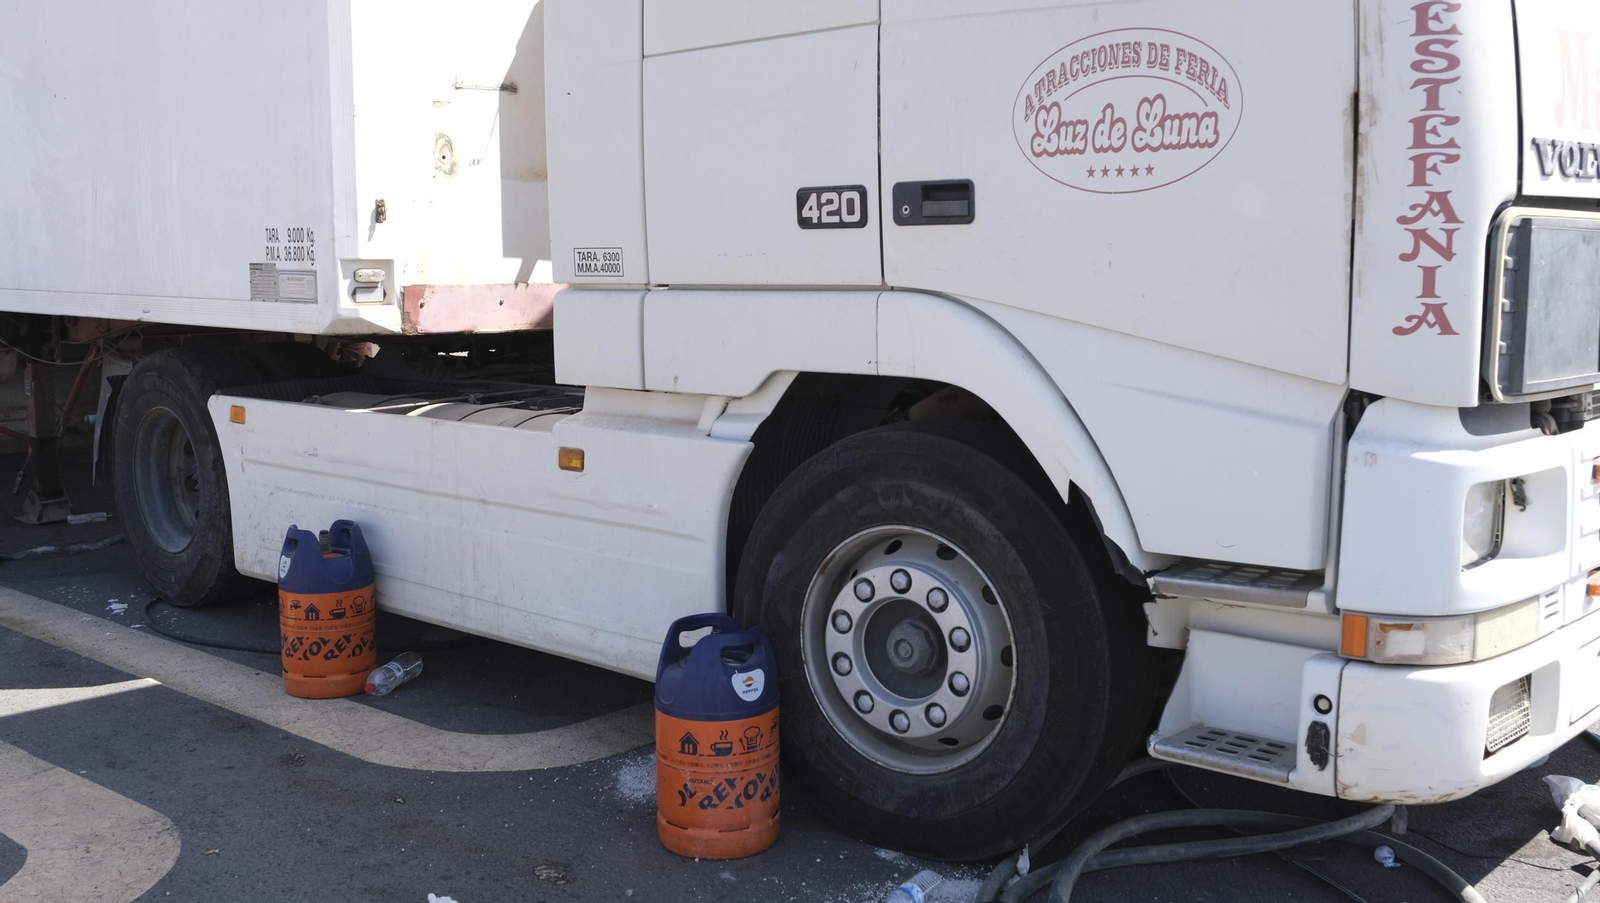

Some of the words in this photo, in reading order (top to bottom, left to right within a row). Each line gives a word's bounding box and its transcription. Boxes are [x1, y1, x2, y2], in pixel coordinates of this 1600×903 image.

[1147, 41, 1171, 71] DE
[1174, 46, 1231, 110] FERIA
[1031, 101, 1089, 158] Luz
[1092, 102, 1127, 154] de
[1131, 93, 1220, 153] Luna
[1391, 0, 1464, 336] ESTEFANIA
[801, 190, 861, 224] 420
[287, 227, 305, 243] 9.000
[284, 246, 305, 262] 36.800
[603, 251, 620, 262] 6300
